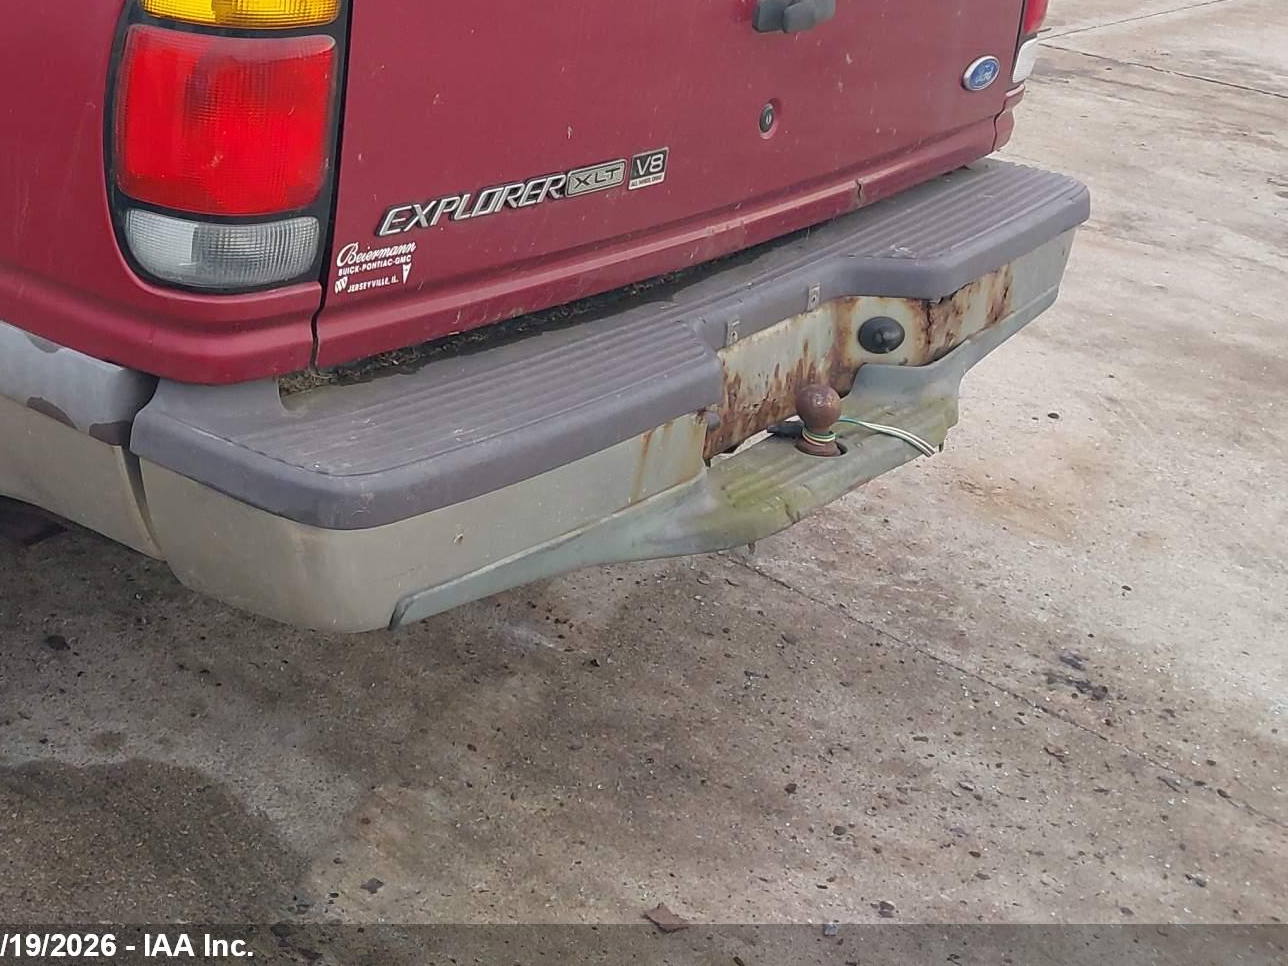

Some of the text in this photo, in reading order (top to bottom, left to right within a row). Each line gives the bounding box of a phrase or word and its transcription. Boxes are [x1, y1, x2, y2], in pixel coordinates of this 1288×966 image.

[636, 153, 664, 176] V8
[378, 166, 623, 236] EXPLORER XLT
[336, 241, 417, 267] Beiermann
